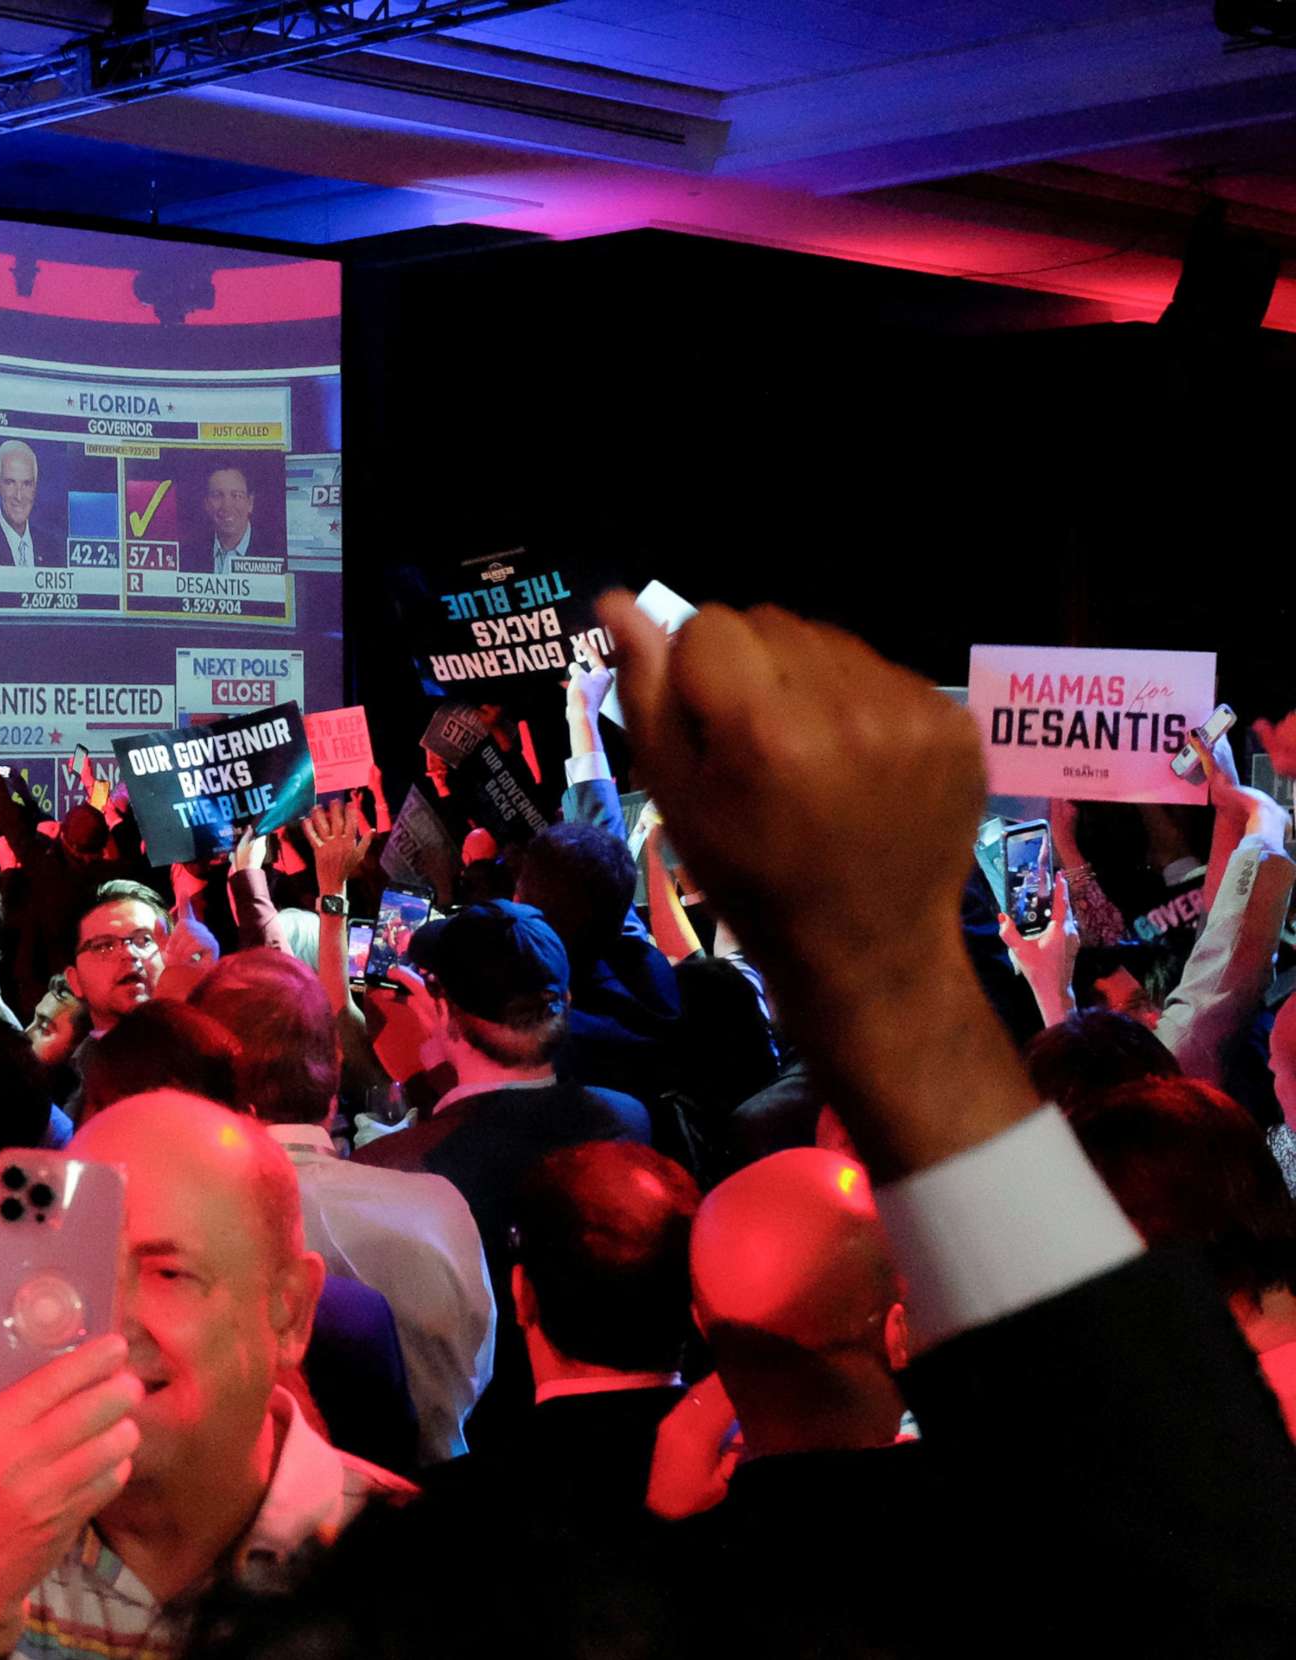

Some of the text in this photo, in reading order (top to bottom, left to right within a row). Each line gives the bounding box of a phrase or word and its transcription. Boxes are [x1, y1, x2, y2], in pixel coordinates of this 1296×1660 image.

[79, 392, 160, 416] FLORIDA
[88, 419, 153, 437] GOVERNOR
[213, 426, 270, 439] JUST CALLED
[70, 544, 118, 566] 42.2%
[128, 545, 176, 567] 57.1%
[234, 561, 283, 574] INCUMBENT
[34, 571, 74, 590] CRIST
[130, 574, 142, 592] R
[175, 575, 251, 597] DESANTIS
[20, 592, 79, 609] 2,607,303
[181, 598, 242, 615] 3,529,904
[440, 570, 572, 621] THE BLUE
[470, 606, 563, 648] BACKS
[429, 625, 616, 683] UR GOVERNOR
[193, 657, 290, 678] NEXT POLLS
[54, 687, 164, 717] RE-ELECTED
[217, 681, 271, 702] CLOSE
[1009, 672, 1175, 715] MAMAS for
[0, 726, 45, 746] 2022
[990, 706, 1187, 754] DESANTIS
[128, 744, 174, 777] OUR
[172, 717, 292, 769] GOVERNOR
[177, 759, 253, 799] BACKS
[480, 745, 550, 835] OUR GOVERNOR
[173, 783, 277, 829] THE BLUE
[484, 779, 517, 822] BACKS
